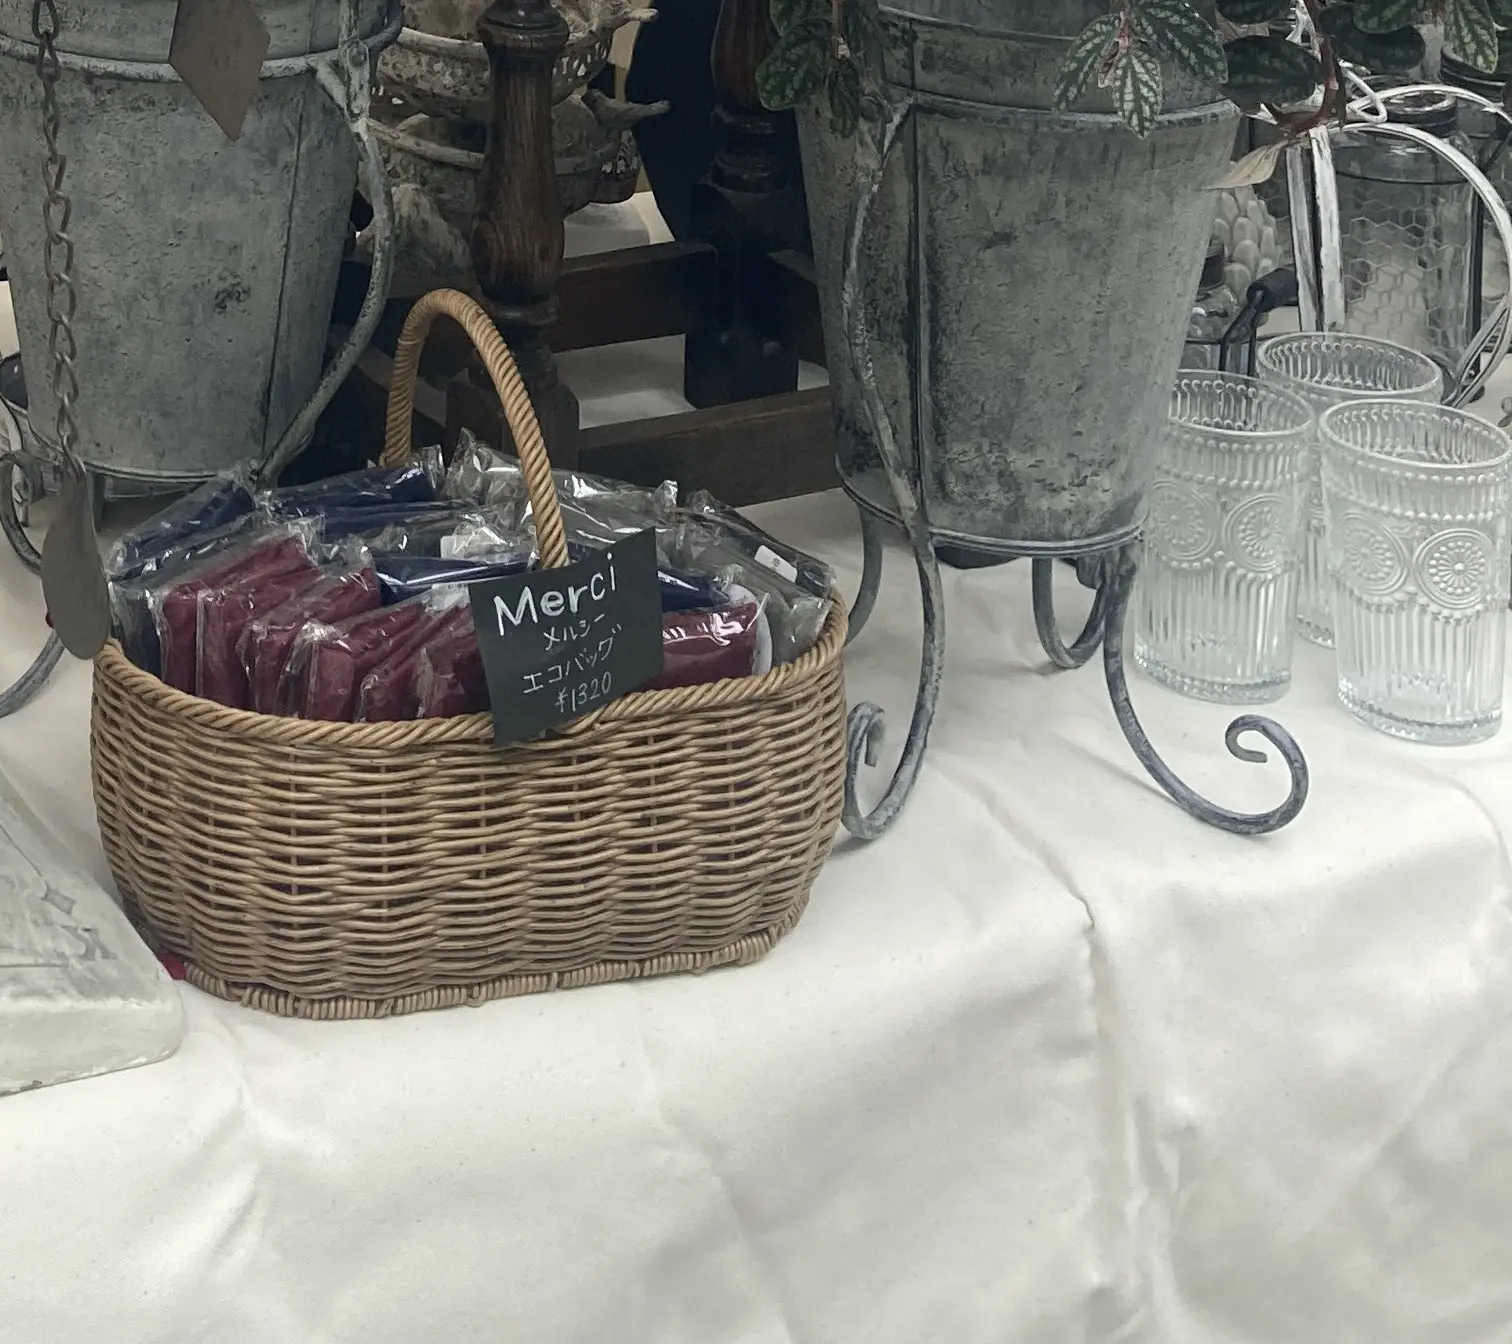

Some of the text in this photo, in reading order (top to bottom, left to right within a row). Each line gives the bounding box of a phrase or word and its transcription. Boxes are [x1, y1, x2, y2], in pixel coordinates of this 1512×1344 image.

[493, 551, 616, 637] Merci
[522, 622, 622, 694] エコバッグ
[543, 613, 605, 651] メルシー
[554, 670, 612, 713] ¥1320
